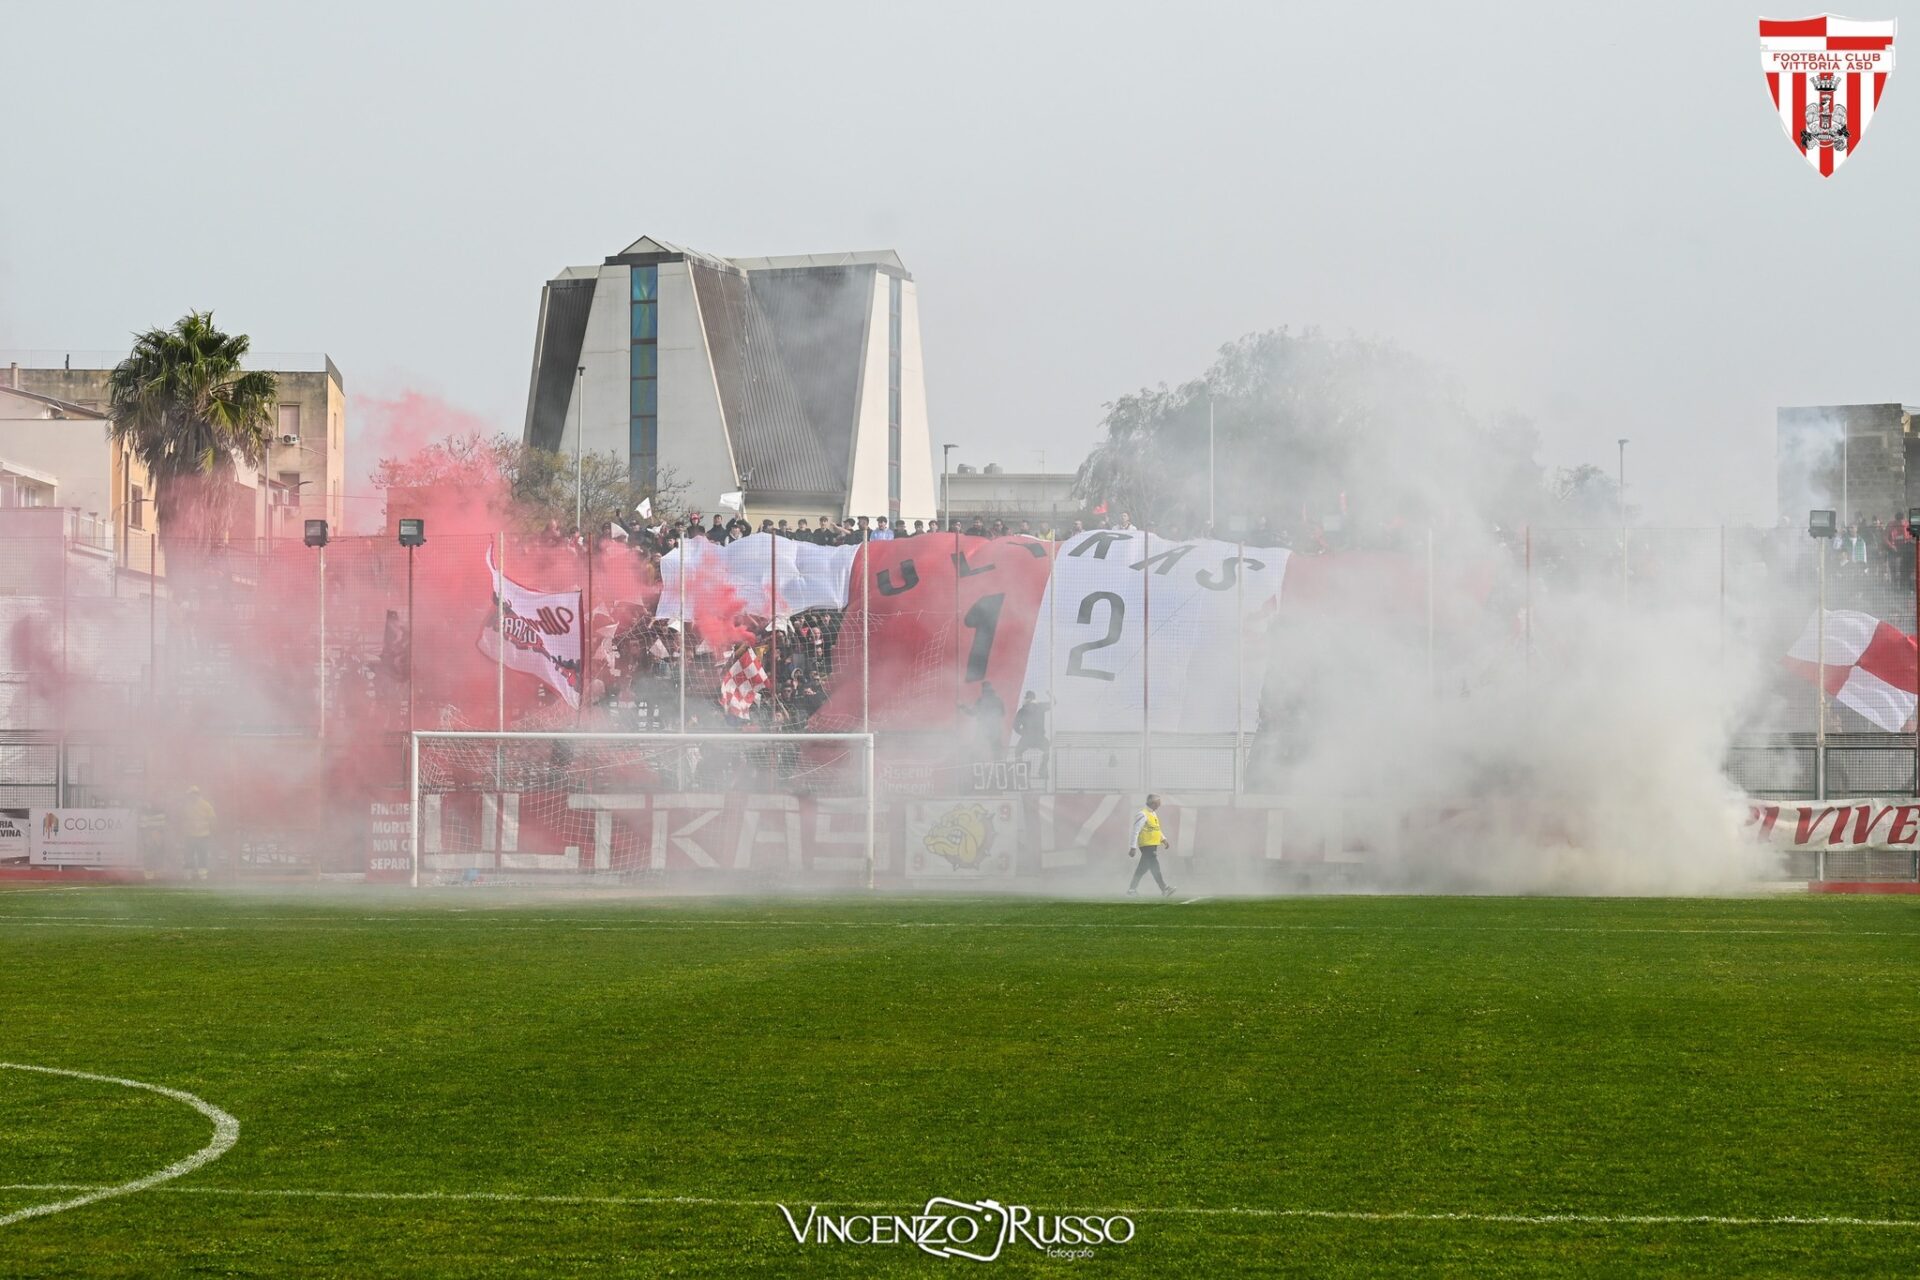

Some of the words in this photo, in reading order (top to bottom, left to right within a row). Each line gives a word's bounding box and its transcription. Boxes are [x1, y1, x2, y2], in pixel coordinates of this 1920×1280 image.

[964, 593, 1005, 683] 1
[1066, 591, 1125, 681] 2
[372, 821, 413, 834] MORTE
[424, 793, 891, 871] ULTRAS
[373, 839, 397, 852] NON
[370, 857, 411, 870] SEPARI
